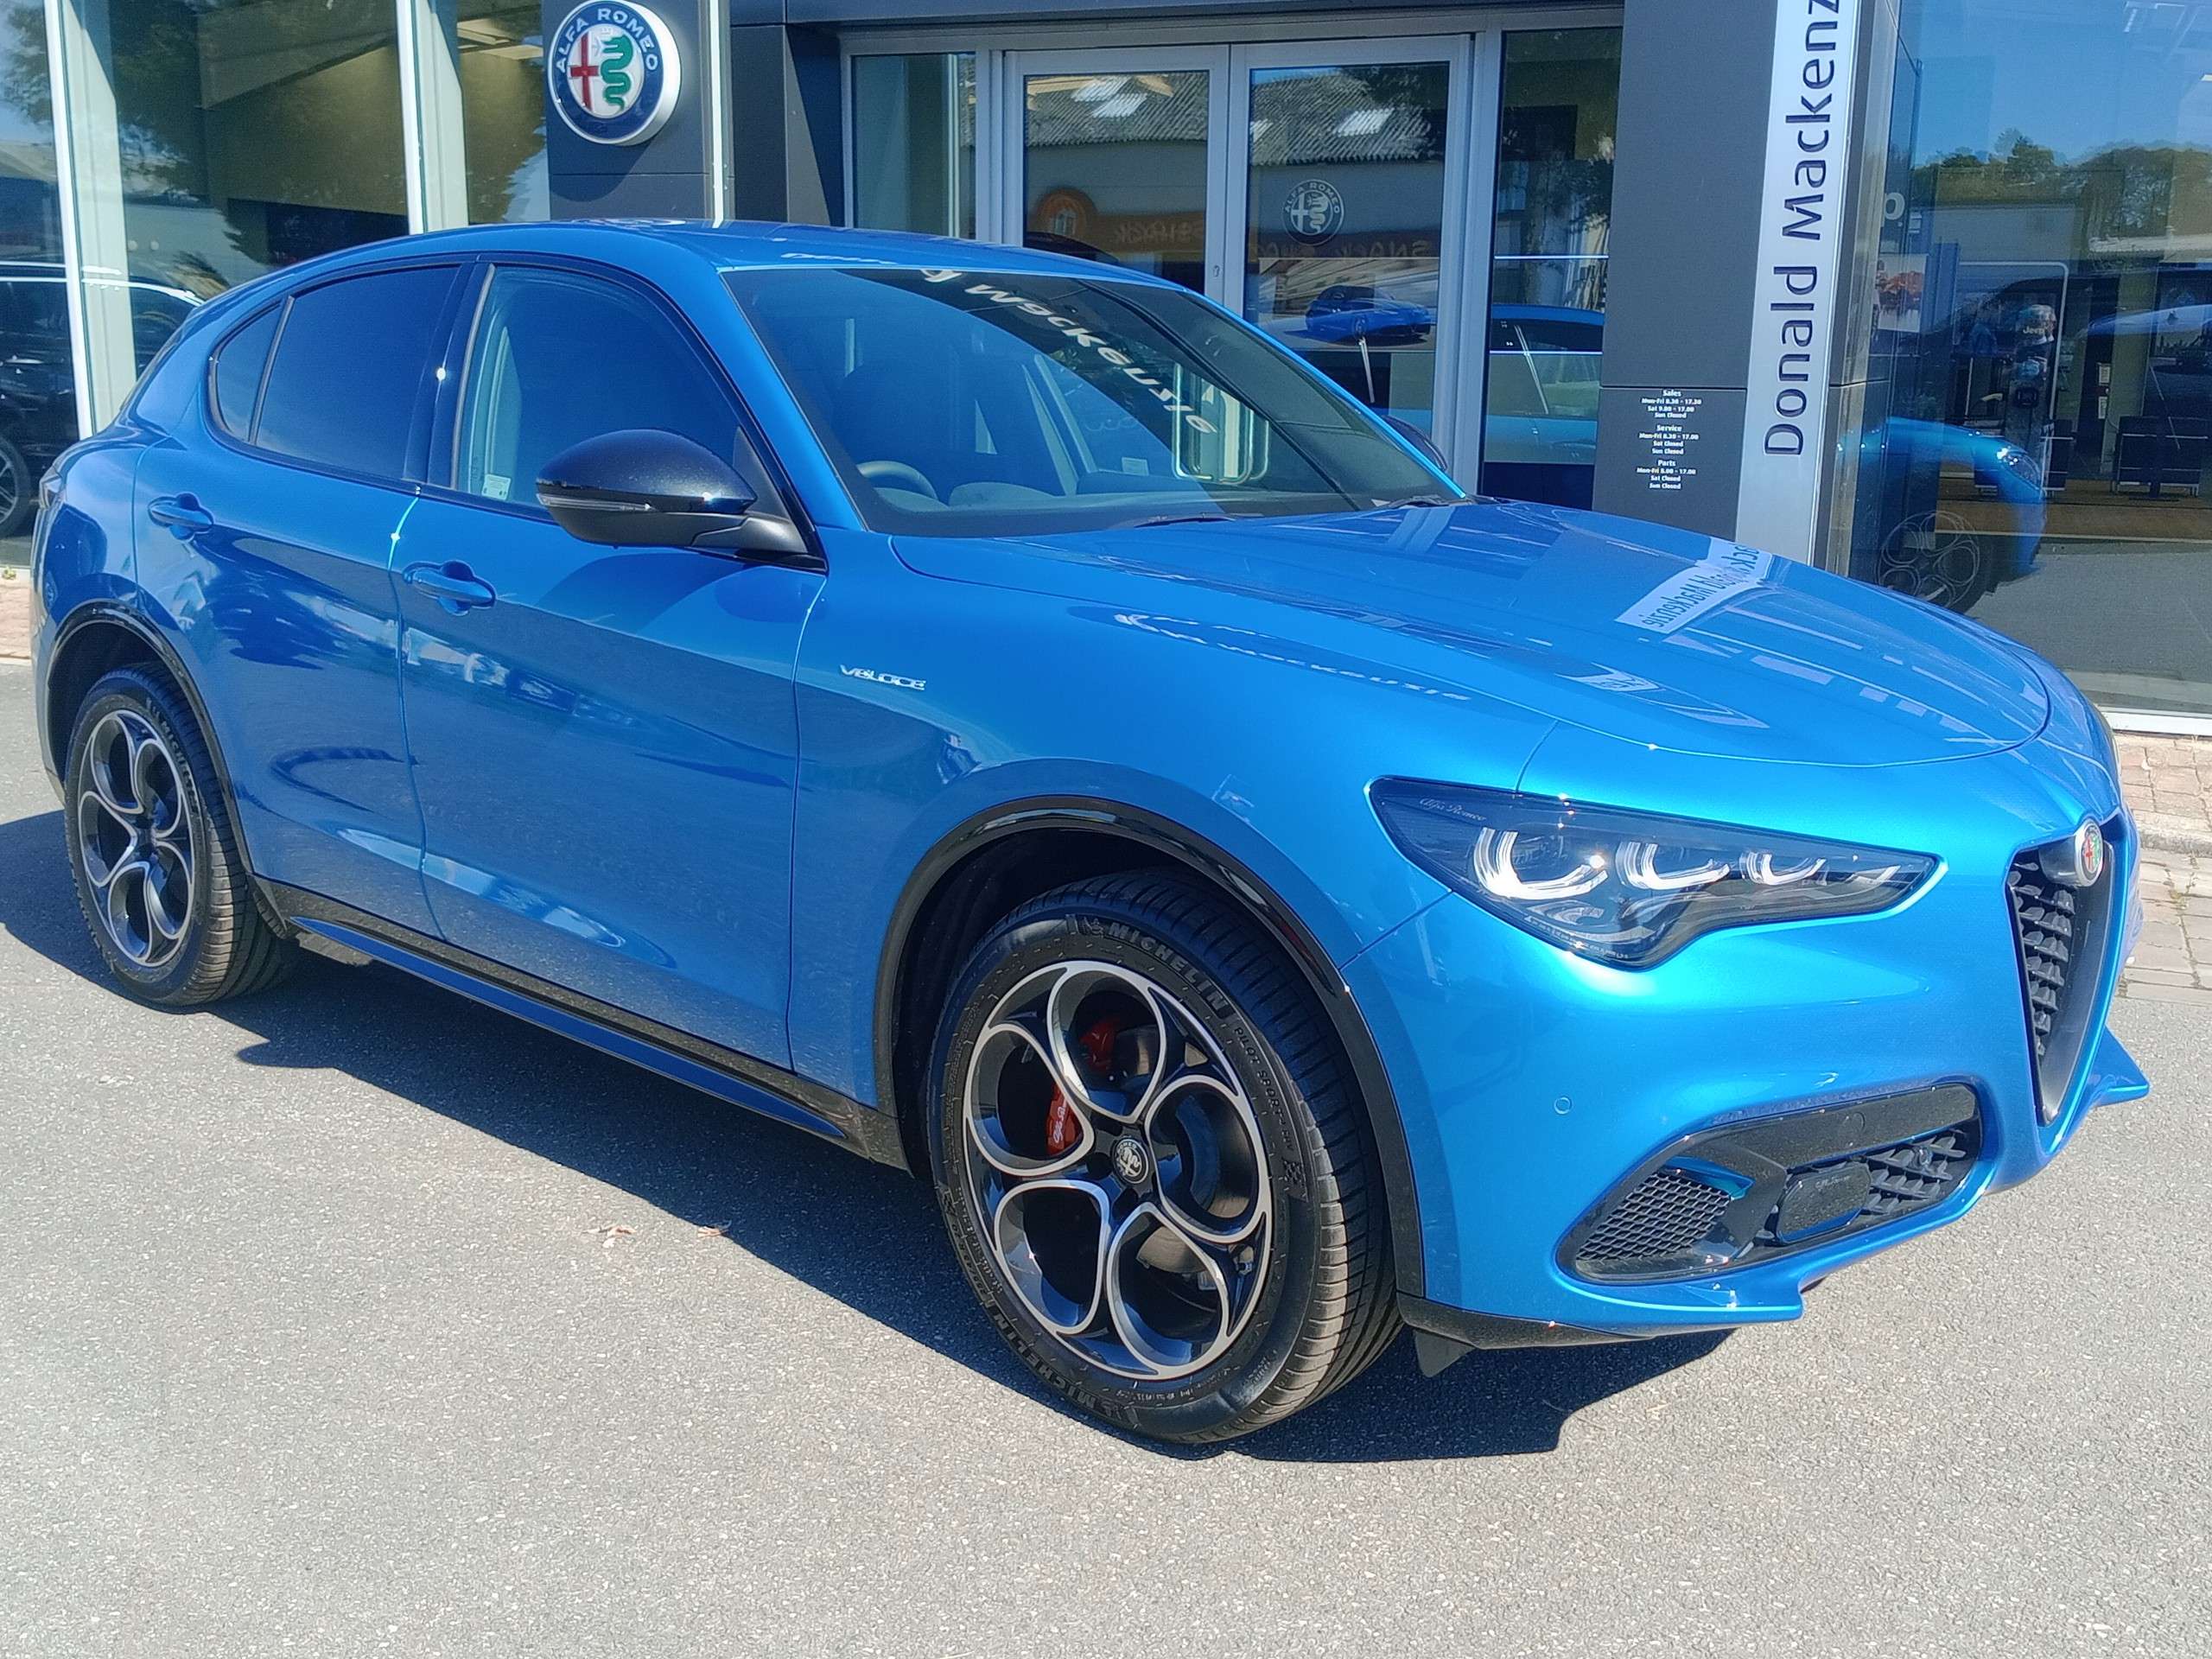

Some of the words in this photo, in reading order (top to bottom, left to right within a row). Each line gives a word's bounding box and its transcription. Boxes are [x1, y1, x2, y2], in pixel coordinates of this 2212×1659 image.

[555, 17, 589, 73] ALFA
[597, 8, 658, 71] ROMEO
[1285, 187, 1305, 213] ALFA
[1309, 182, 1341, 214] ROMEO
[1764, 265, 1818, 455] Donald
[1108, 921, 1230, 1012] MICHELIN
[1233, 1027, 1261, 1065] PILOT
[1256, 1070, 1283, 1116] SPORT
[994, 1313, 1096, 1409] MICHELIN
